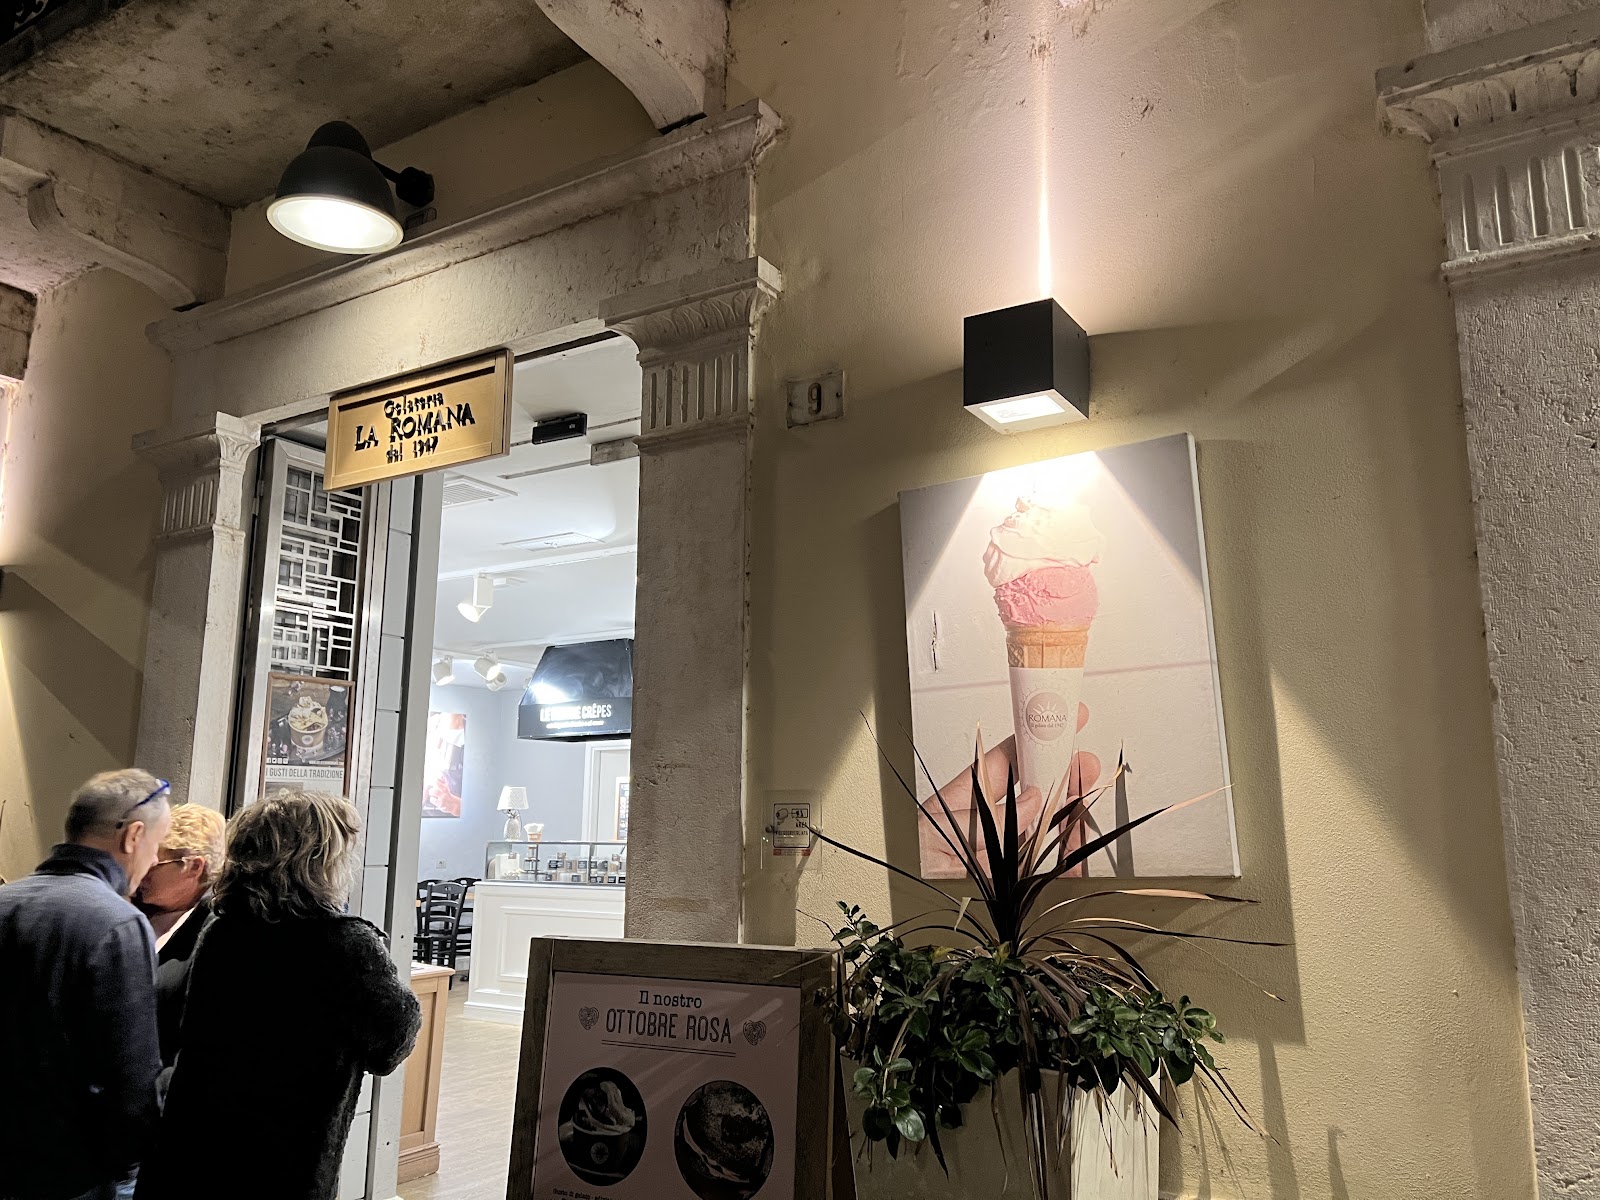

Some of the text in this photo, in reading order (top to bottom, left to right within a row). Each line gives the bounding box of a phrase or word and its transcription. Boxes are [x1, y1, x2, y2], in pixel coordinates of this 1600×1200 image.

[807, 382, 822, 416] 9
[354, 402, 476, 451] LA ROMANA
[581, 703, 612, 719] CRÊPES
[1028, 714, 1067, 722] ROMANA
[269, 767, 288, 777] GUSTI
[288, 768, 308, 778] DELLA
[308, 769, 343, 779] TRADIZIONE
[638, 990, 702, 1009] Il nostro
[606, 1008, 732, 1044] OTTOBRE ROSA
